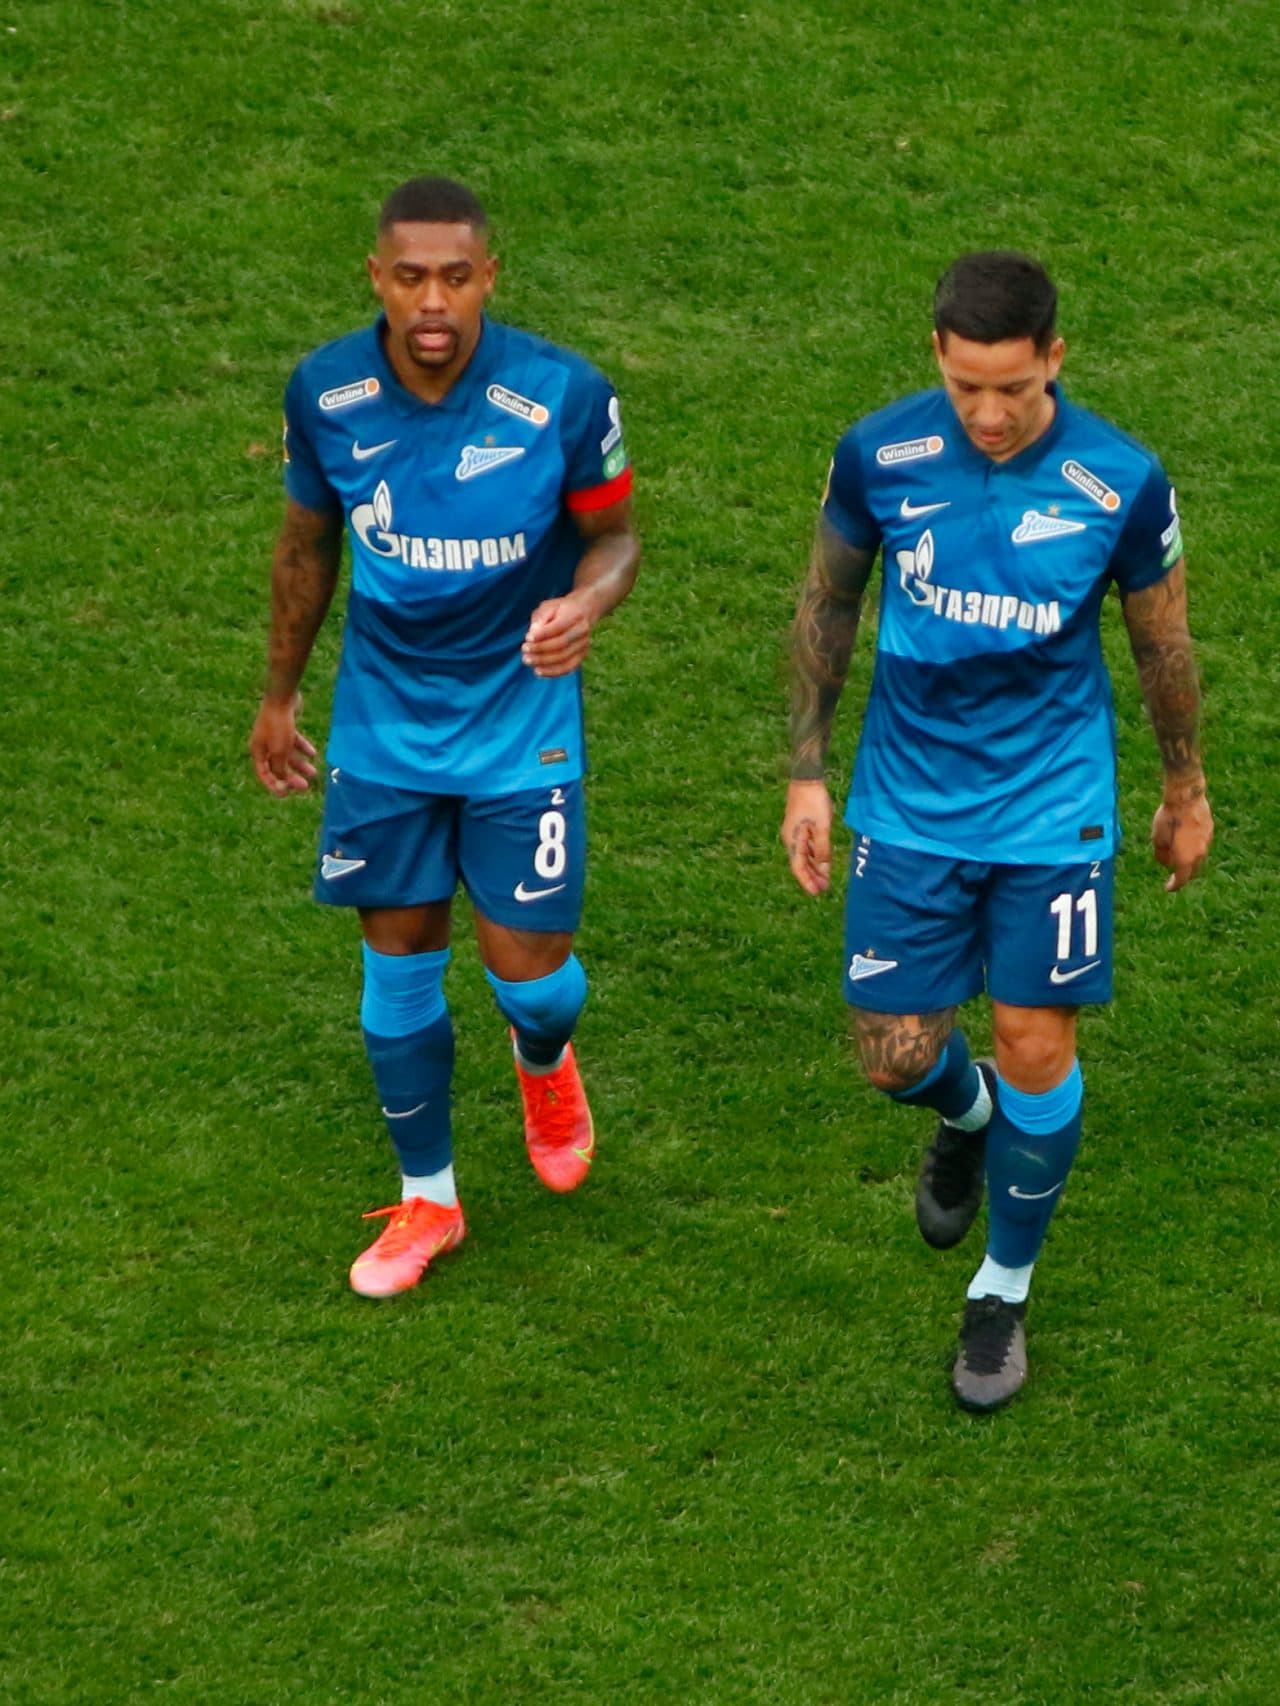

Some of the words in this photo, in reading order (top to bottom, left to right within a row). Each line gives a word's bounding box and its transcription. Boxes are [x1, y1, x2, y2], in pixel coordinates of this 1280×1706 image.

[324, 386, 364, 406] Winline
[493, 388, 530, 415] Winline
[882, 444, 925, 460] Winline
[1068, 464, 1104, 497] Winline
[400, 532, 527, 570] ГАЗПРОМ
[933, 584, 1061, 635] ГАЗПРОМ
[534, 811, 566, 878] 8
[1051, 888, 1098, 960] 11
